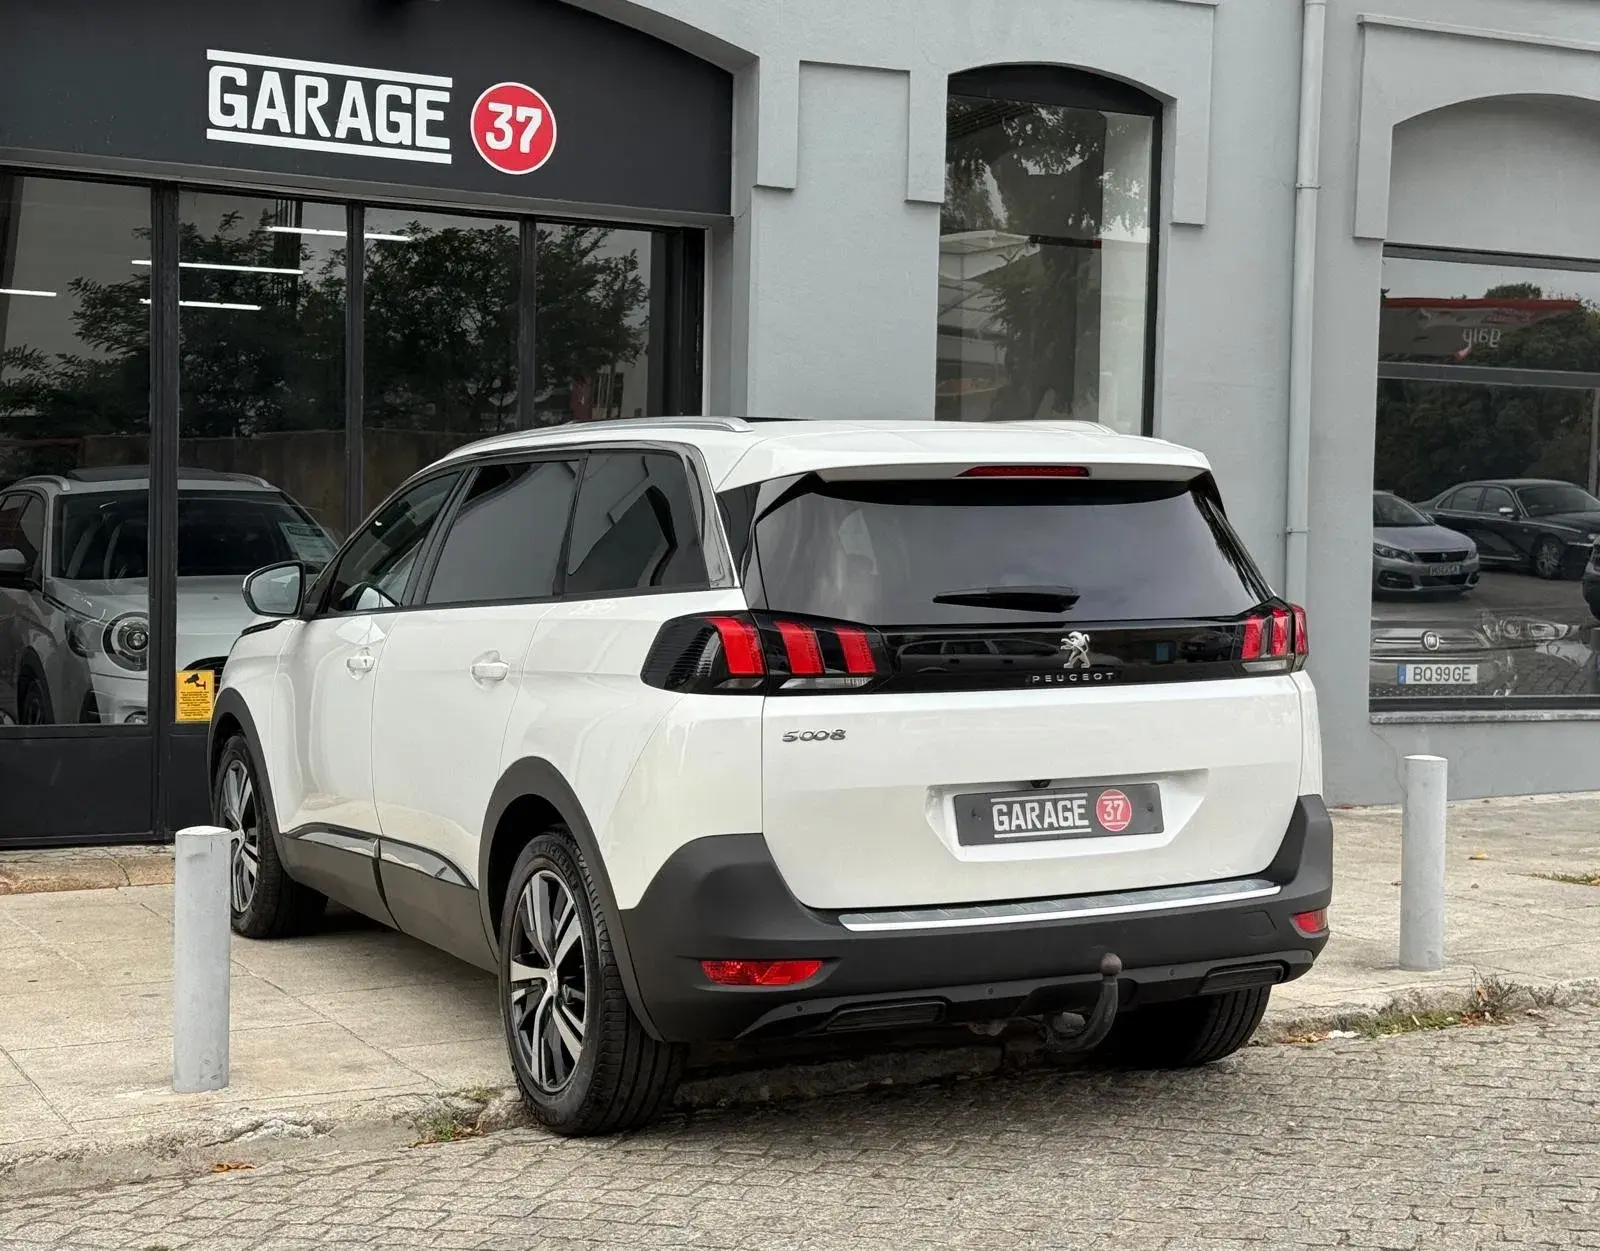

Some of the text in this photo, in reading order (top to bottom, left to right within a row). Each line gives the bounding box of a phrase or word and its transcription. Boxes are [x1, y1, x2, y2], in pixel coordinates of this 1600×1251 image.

[208, 65, 543, 154] GARAGE 37
[1031, 672, 1114, 683] PEUGEOT
[782, 729, 846, 742] 5008
[992, 799, 1124, 832] GARAGE 37
